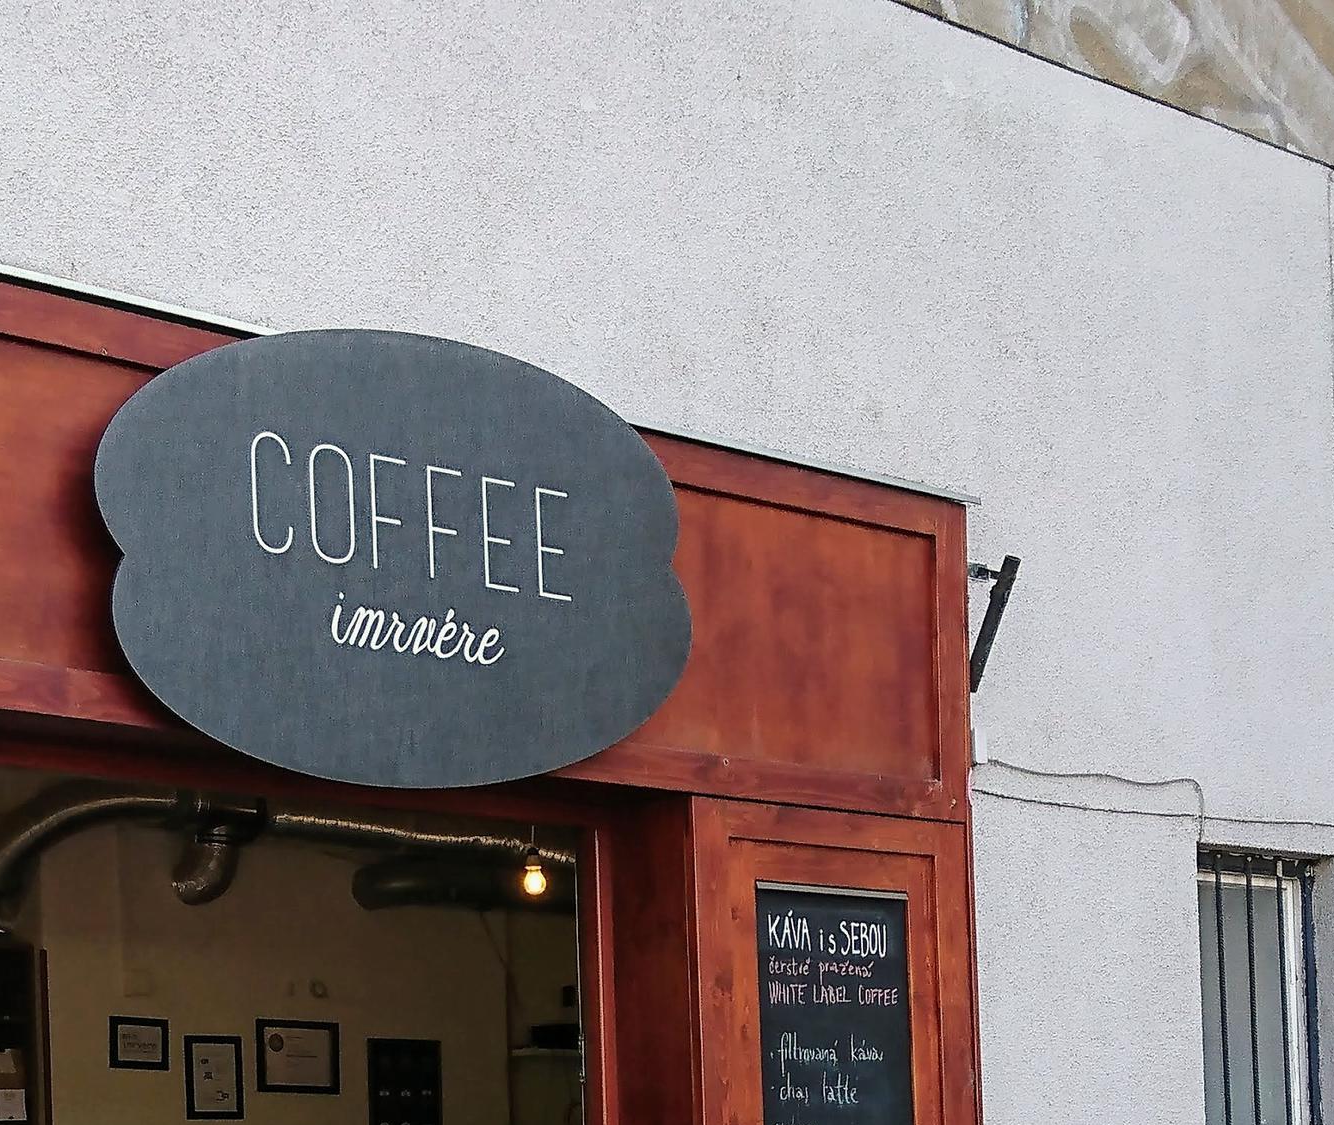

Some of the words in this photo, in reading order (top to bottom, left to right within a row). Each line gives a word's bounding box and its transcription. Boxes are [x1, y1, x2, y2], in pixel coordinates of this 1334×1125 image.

[251, 431, 573, 602] COFFEE
[767, 909, 812, 951] KÁVA
[839, 920, 887, 958] SEBOU
[768, 980, 808, 1005] WHITE
[813, 984, 851, 1006] LABEL
[858, 984, 898, 1006] COFFEE
[850, 1033, 884, 1062] káva
[822, 1071, 859, 1105] latte
